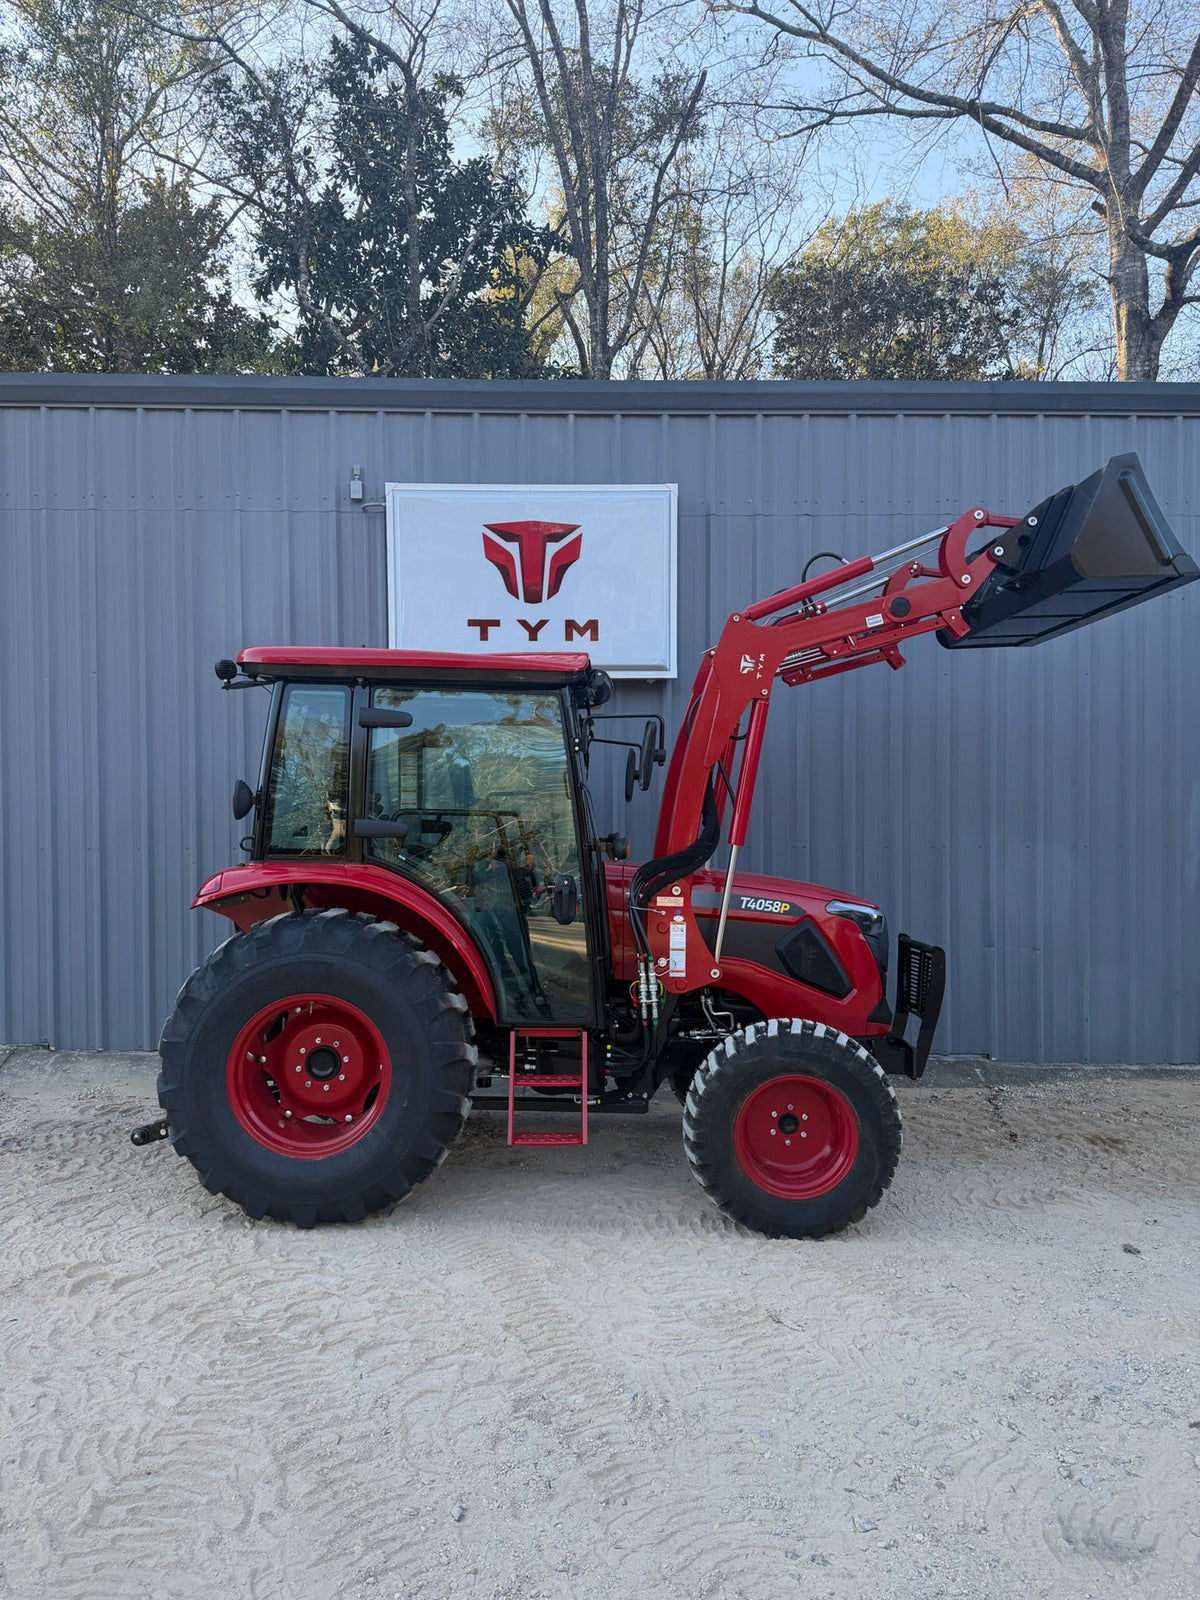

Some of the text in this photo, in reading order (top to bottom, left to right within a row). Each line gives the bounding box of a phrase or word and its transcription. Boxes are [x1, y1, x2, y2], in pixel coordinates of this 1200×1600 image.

[467, 619, 599, 641] TYM
[756, 653, 765, 679] TYM
[740, 896, 790, 914] T4058P
